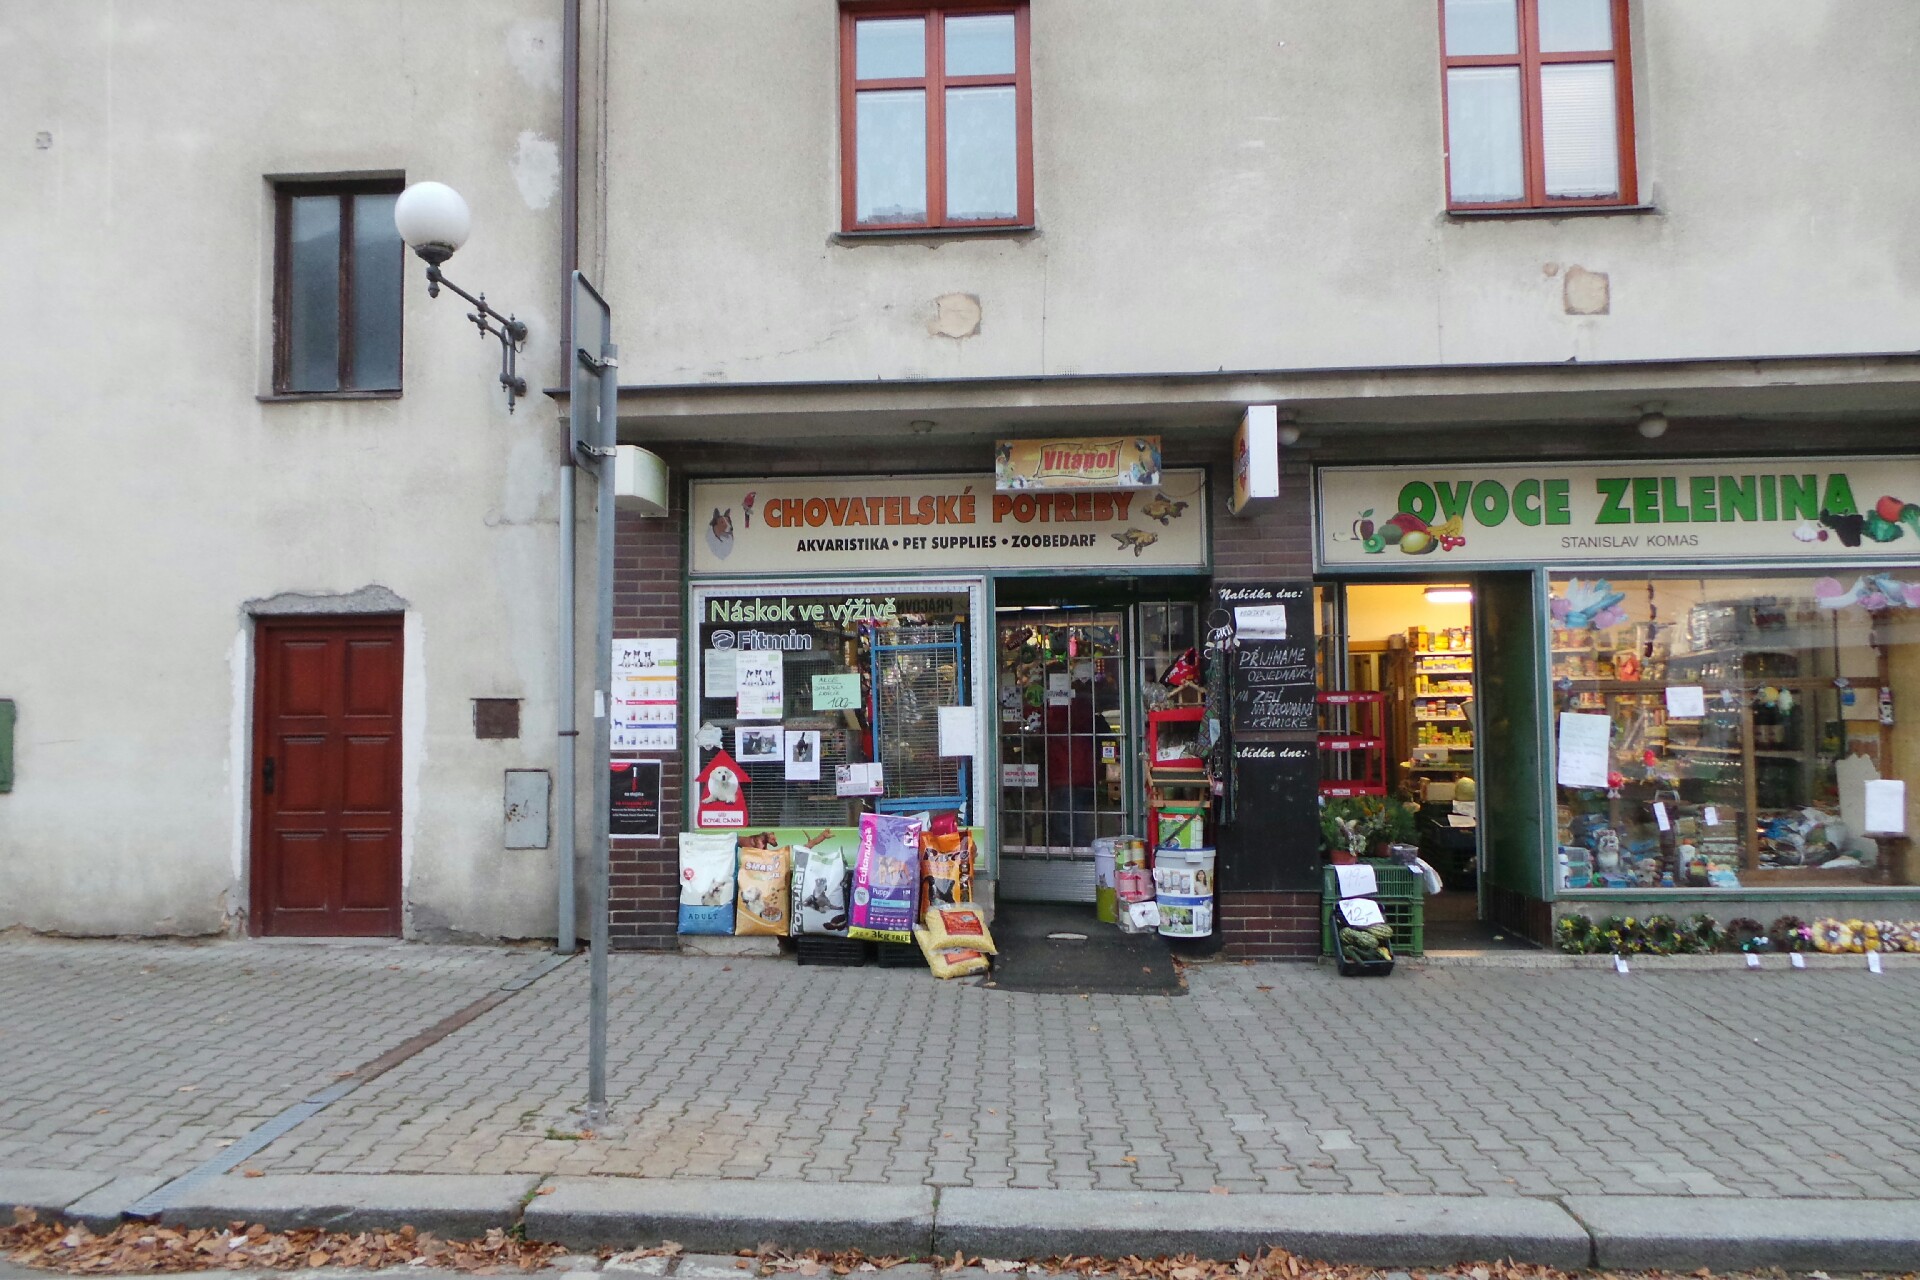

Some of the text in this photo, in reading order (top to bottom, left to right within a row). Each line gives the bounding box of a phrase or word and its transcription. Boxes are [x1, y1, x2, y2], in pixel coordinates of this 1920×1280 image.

[1044, 450, 1116, 471] Vitapol
[763, 487, 976, 528] CHOVATELSKÉ
[1398, 473, 1862, 526] OVOCE ZELENINA
[797, 534, 1096, 553] AKVARISTIKA PET SUPPLIES ZOOBEDARF
[1562, 534, 1700, 550] STANISLAV KOMAS
[1219, 589, 1303, 600] Nabídka dne:
[711, 597, 897, 628] Náskok ve výživě
[737, 628, 812, 651] Fitmin
[1279, 746, 1306, 757] dne:
[859, 827, 873, 885] Eukanuba
[872, 887, 890, 898] Puppy
[872, 930, 889, 940] 3kg
